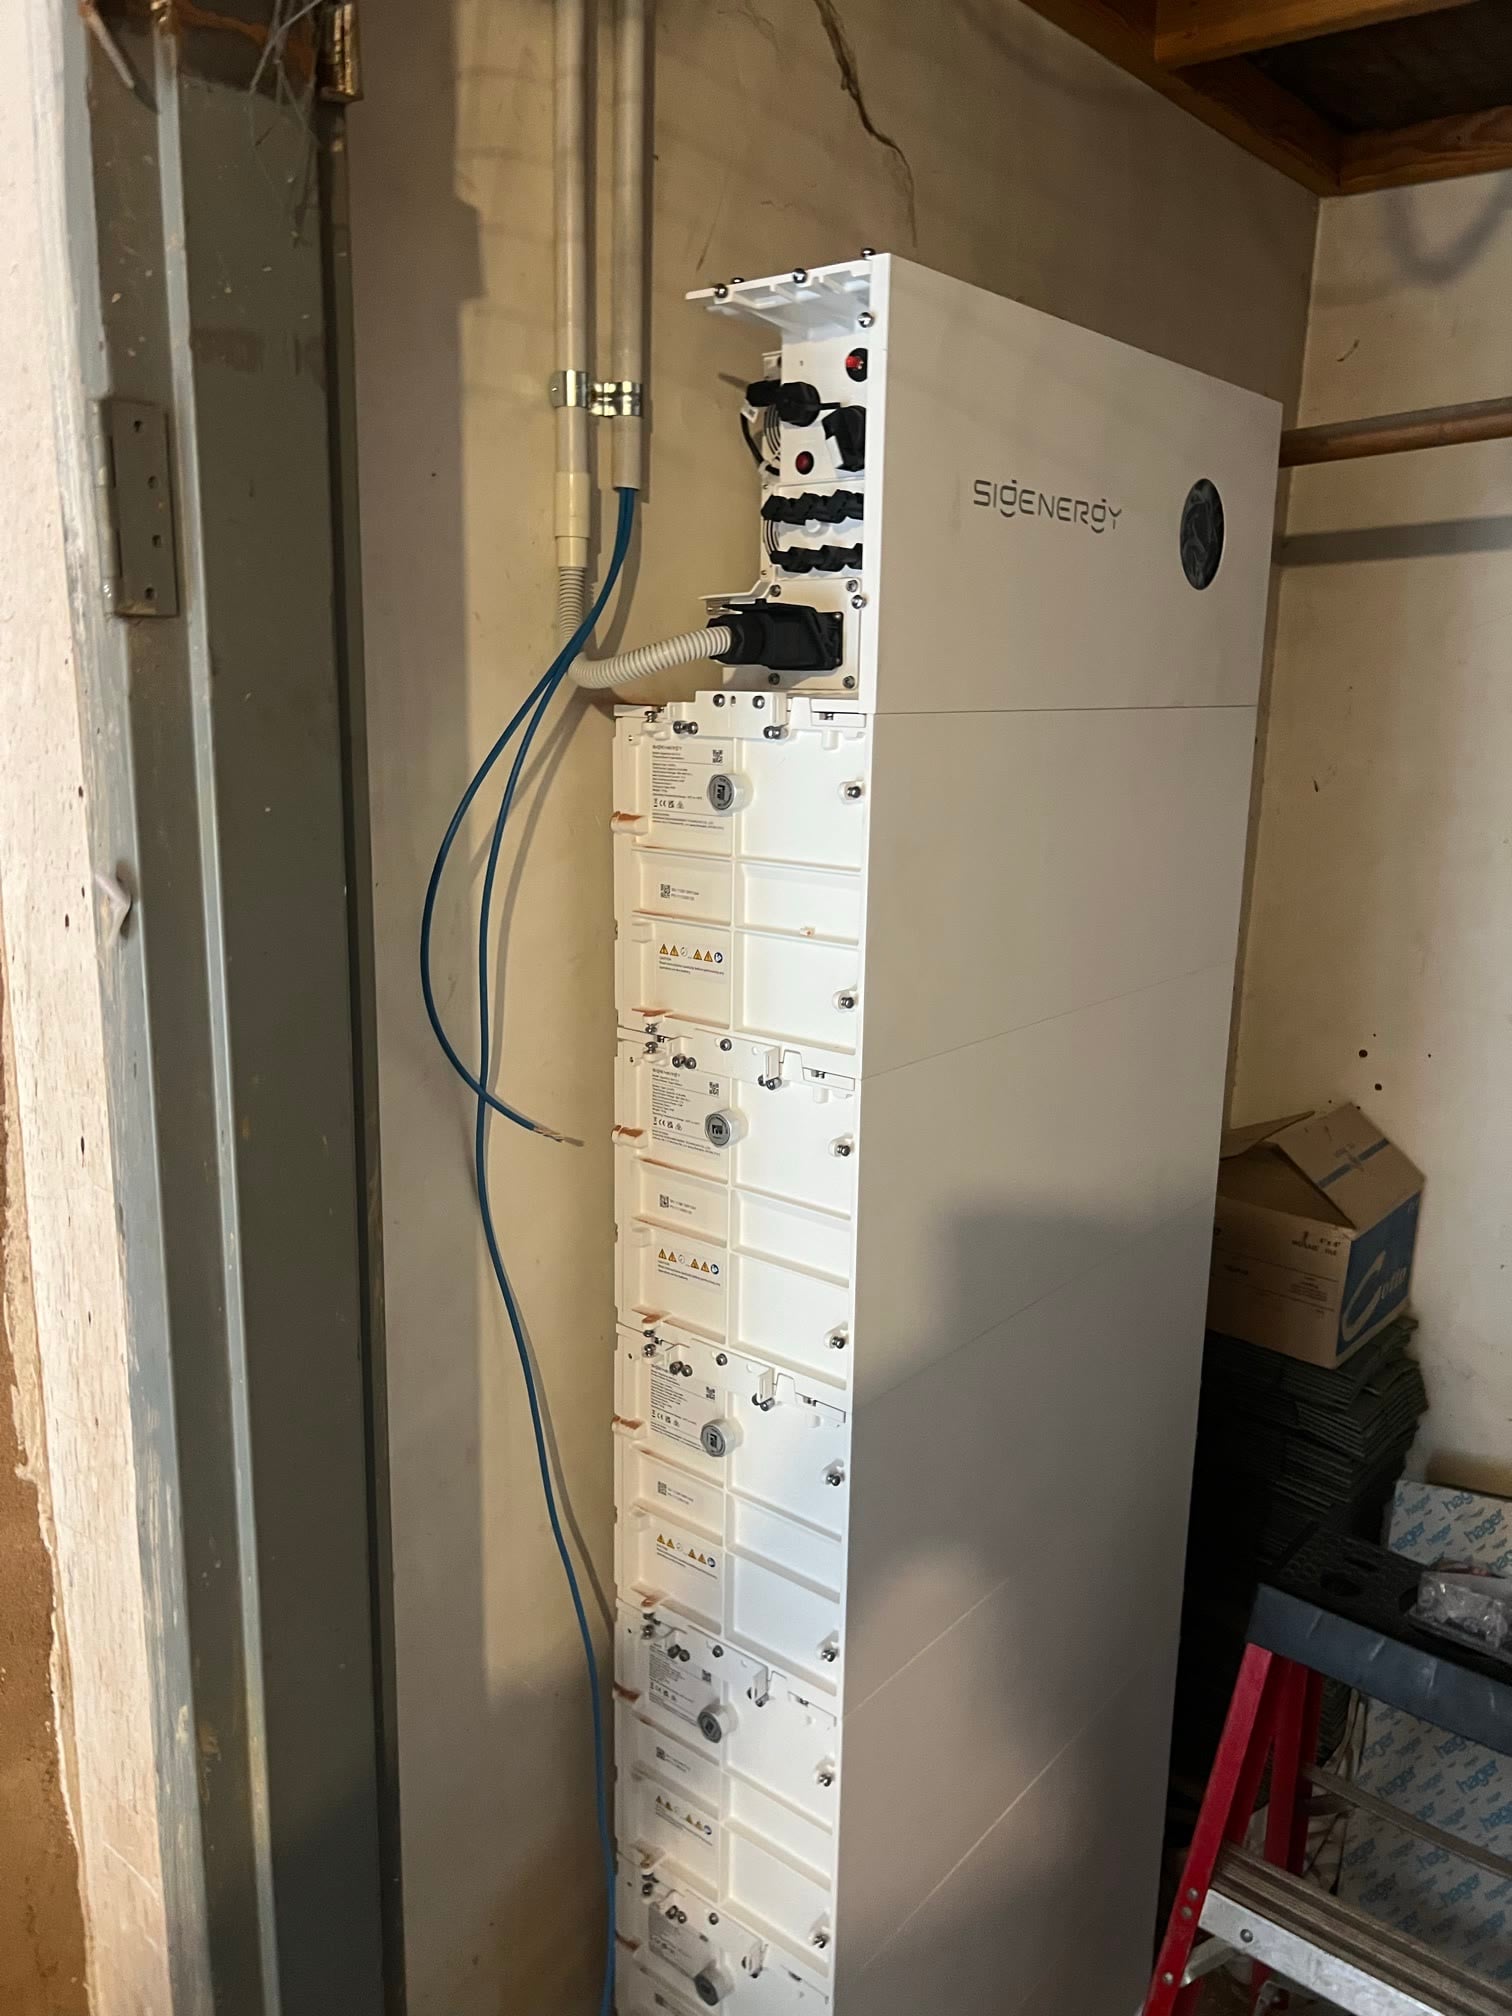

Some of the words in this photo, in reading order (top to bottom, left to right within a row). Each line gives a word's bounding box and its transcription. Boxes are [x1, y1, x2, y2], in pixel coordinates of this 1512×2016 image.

[973, 479, 1122, 534] SIGENERGY
[1442, 1491, 1474, 1512] hag
[1464, 1509, 1505, 1544] hager
[1433, 1736, 1468, 1759] hag
